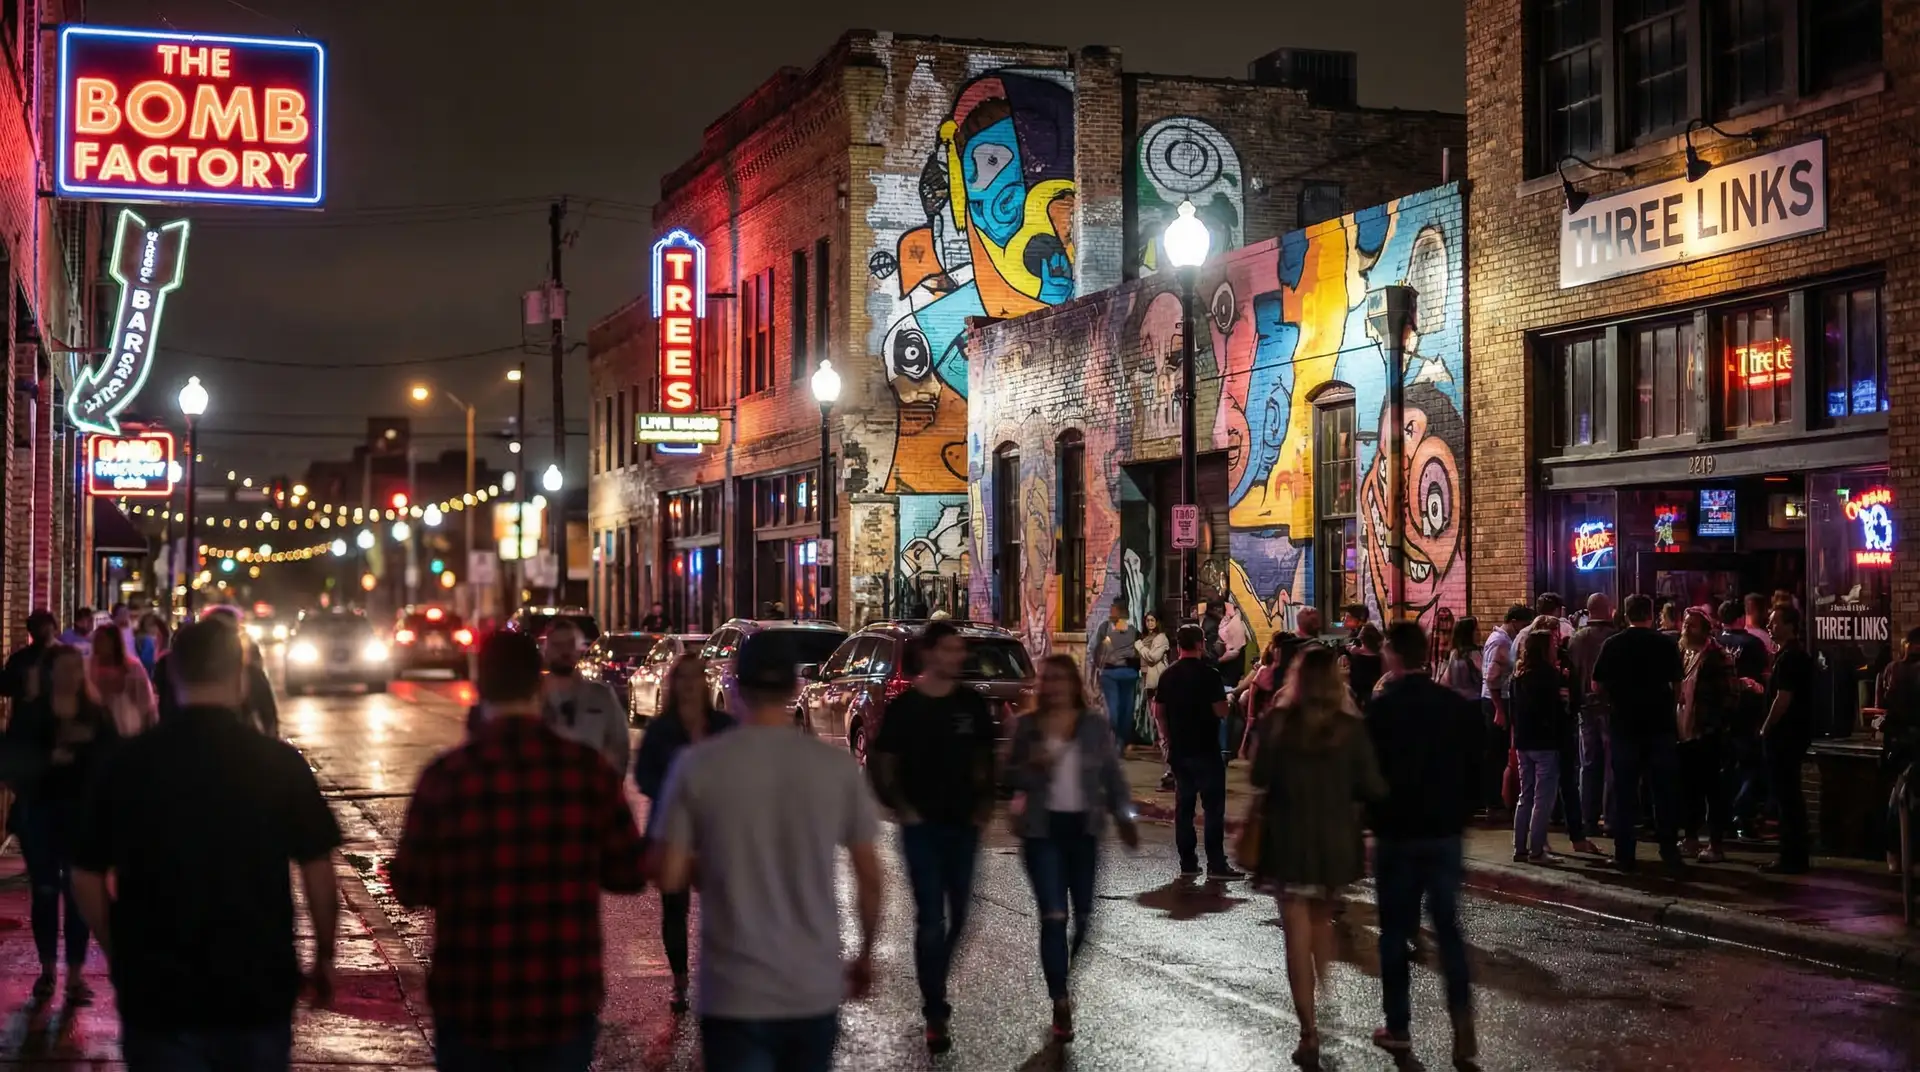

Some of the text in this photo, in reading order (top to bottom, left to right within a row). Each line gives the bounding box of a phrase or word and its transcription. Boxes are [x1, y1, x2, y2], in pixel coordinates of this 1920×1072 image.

[157, 45, 231, 77] THE
[76, 77, 309, 144] BOMB
[74, 142, 308, 189] FACTORY
[1569, 159, 1813, 268] THREE LINKS
[665, 253, 693, 409] TREES
[1815, 616, 1888, 640] THREE LINKS
